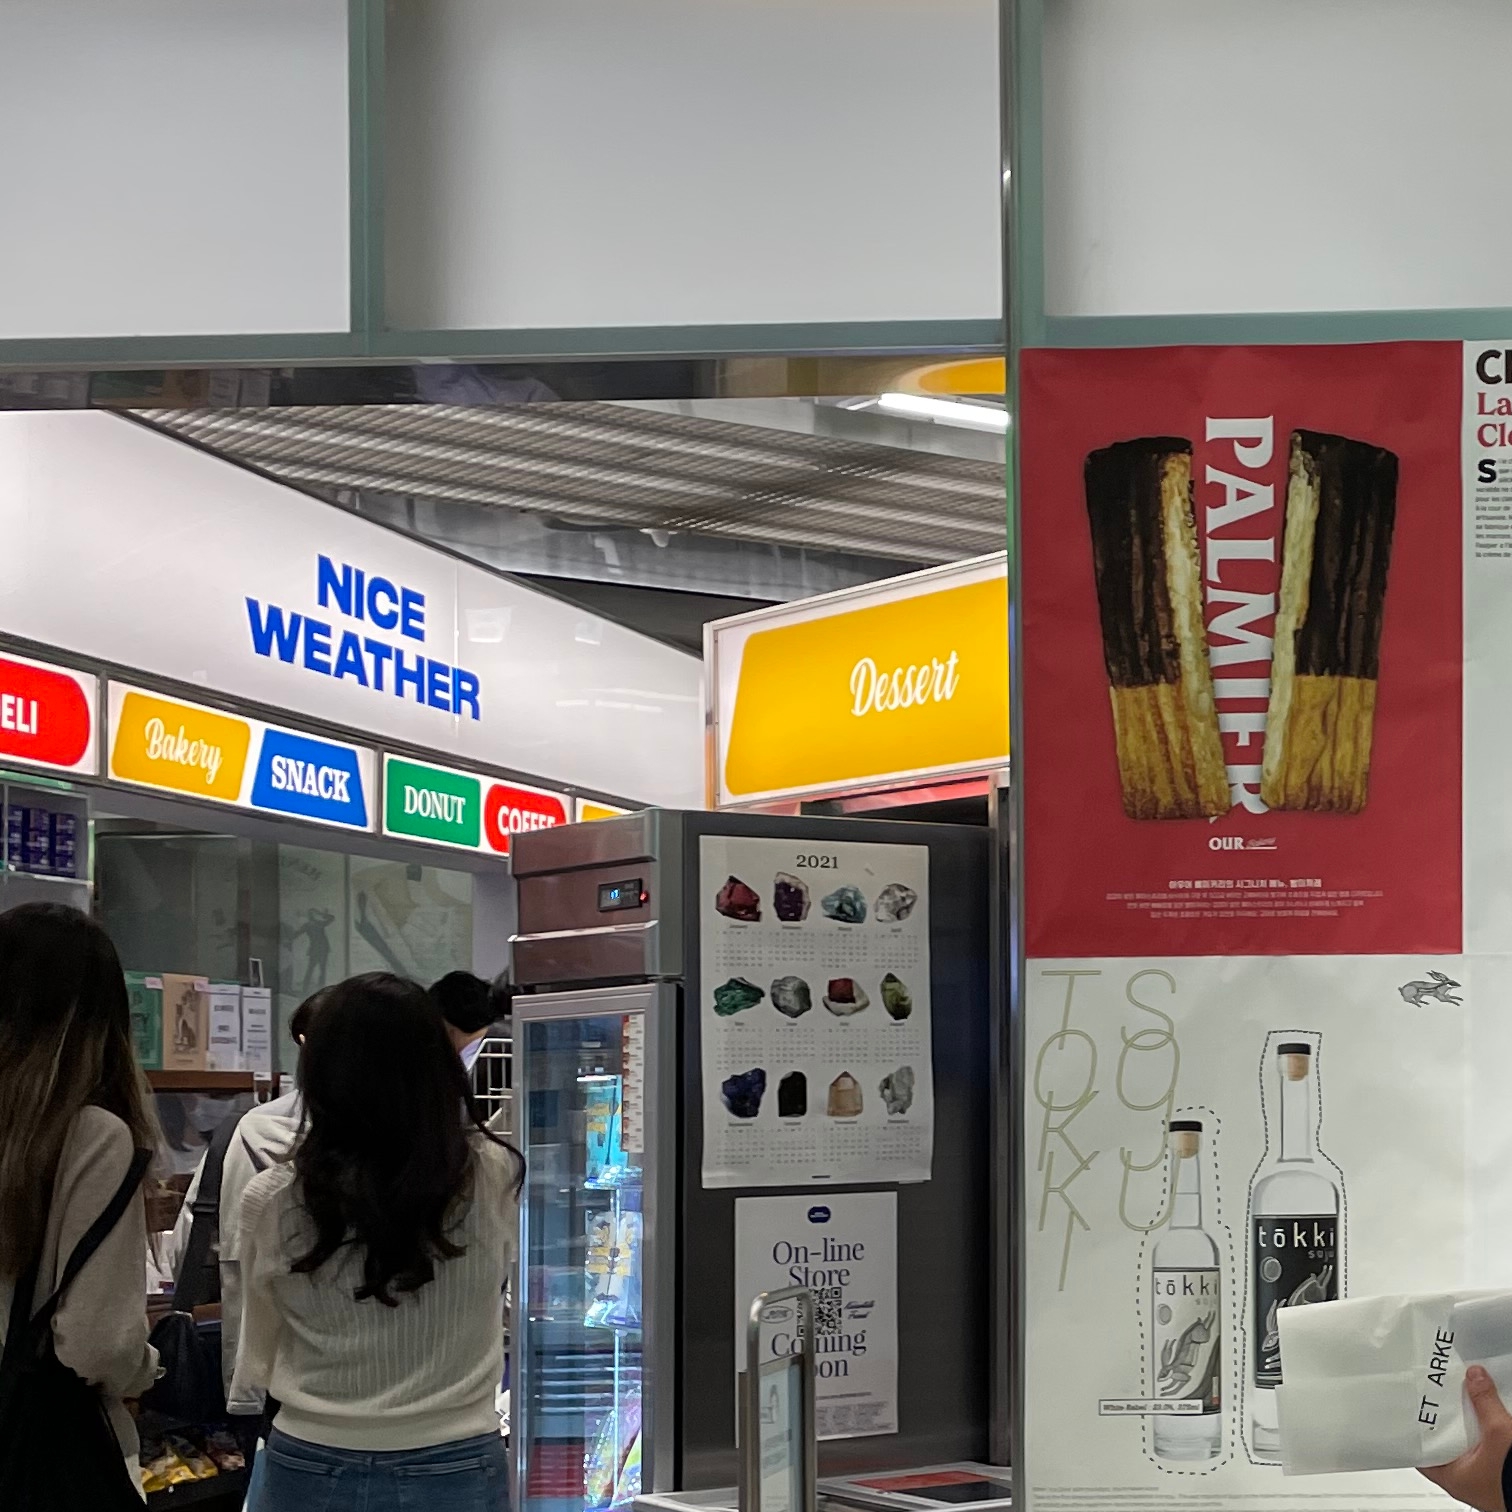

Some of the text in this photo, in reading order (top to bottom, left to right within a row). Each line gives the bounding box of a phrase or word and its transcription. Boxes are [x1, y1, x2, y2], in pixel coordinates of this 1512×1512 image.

[318, 554, 425, 642] NICE
[245, 597, 481, 720] WEATHER
[850, 650, 959, 716] Dessert
[1, 693, 37, 735] ELI
[144, 717, 222, 785] Bakery
[271, 754, 351, 803] SNACK
[403, 785, 466, 825] DONUT
[796, 855, 839, 869] 2021
[1209, 837, 1244, 850] OUR
[772, 1237, 864, 1265] On-line
[789, 1265, 850, 1288] Store
[1418, 1394, 1439, 1430] ET
